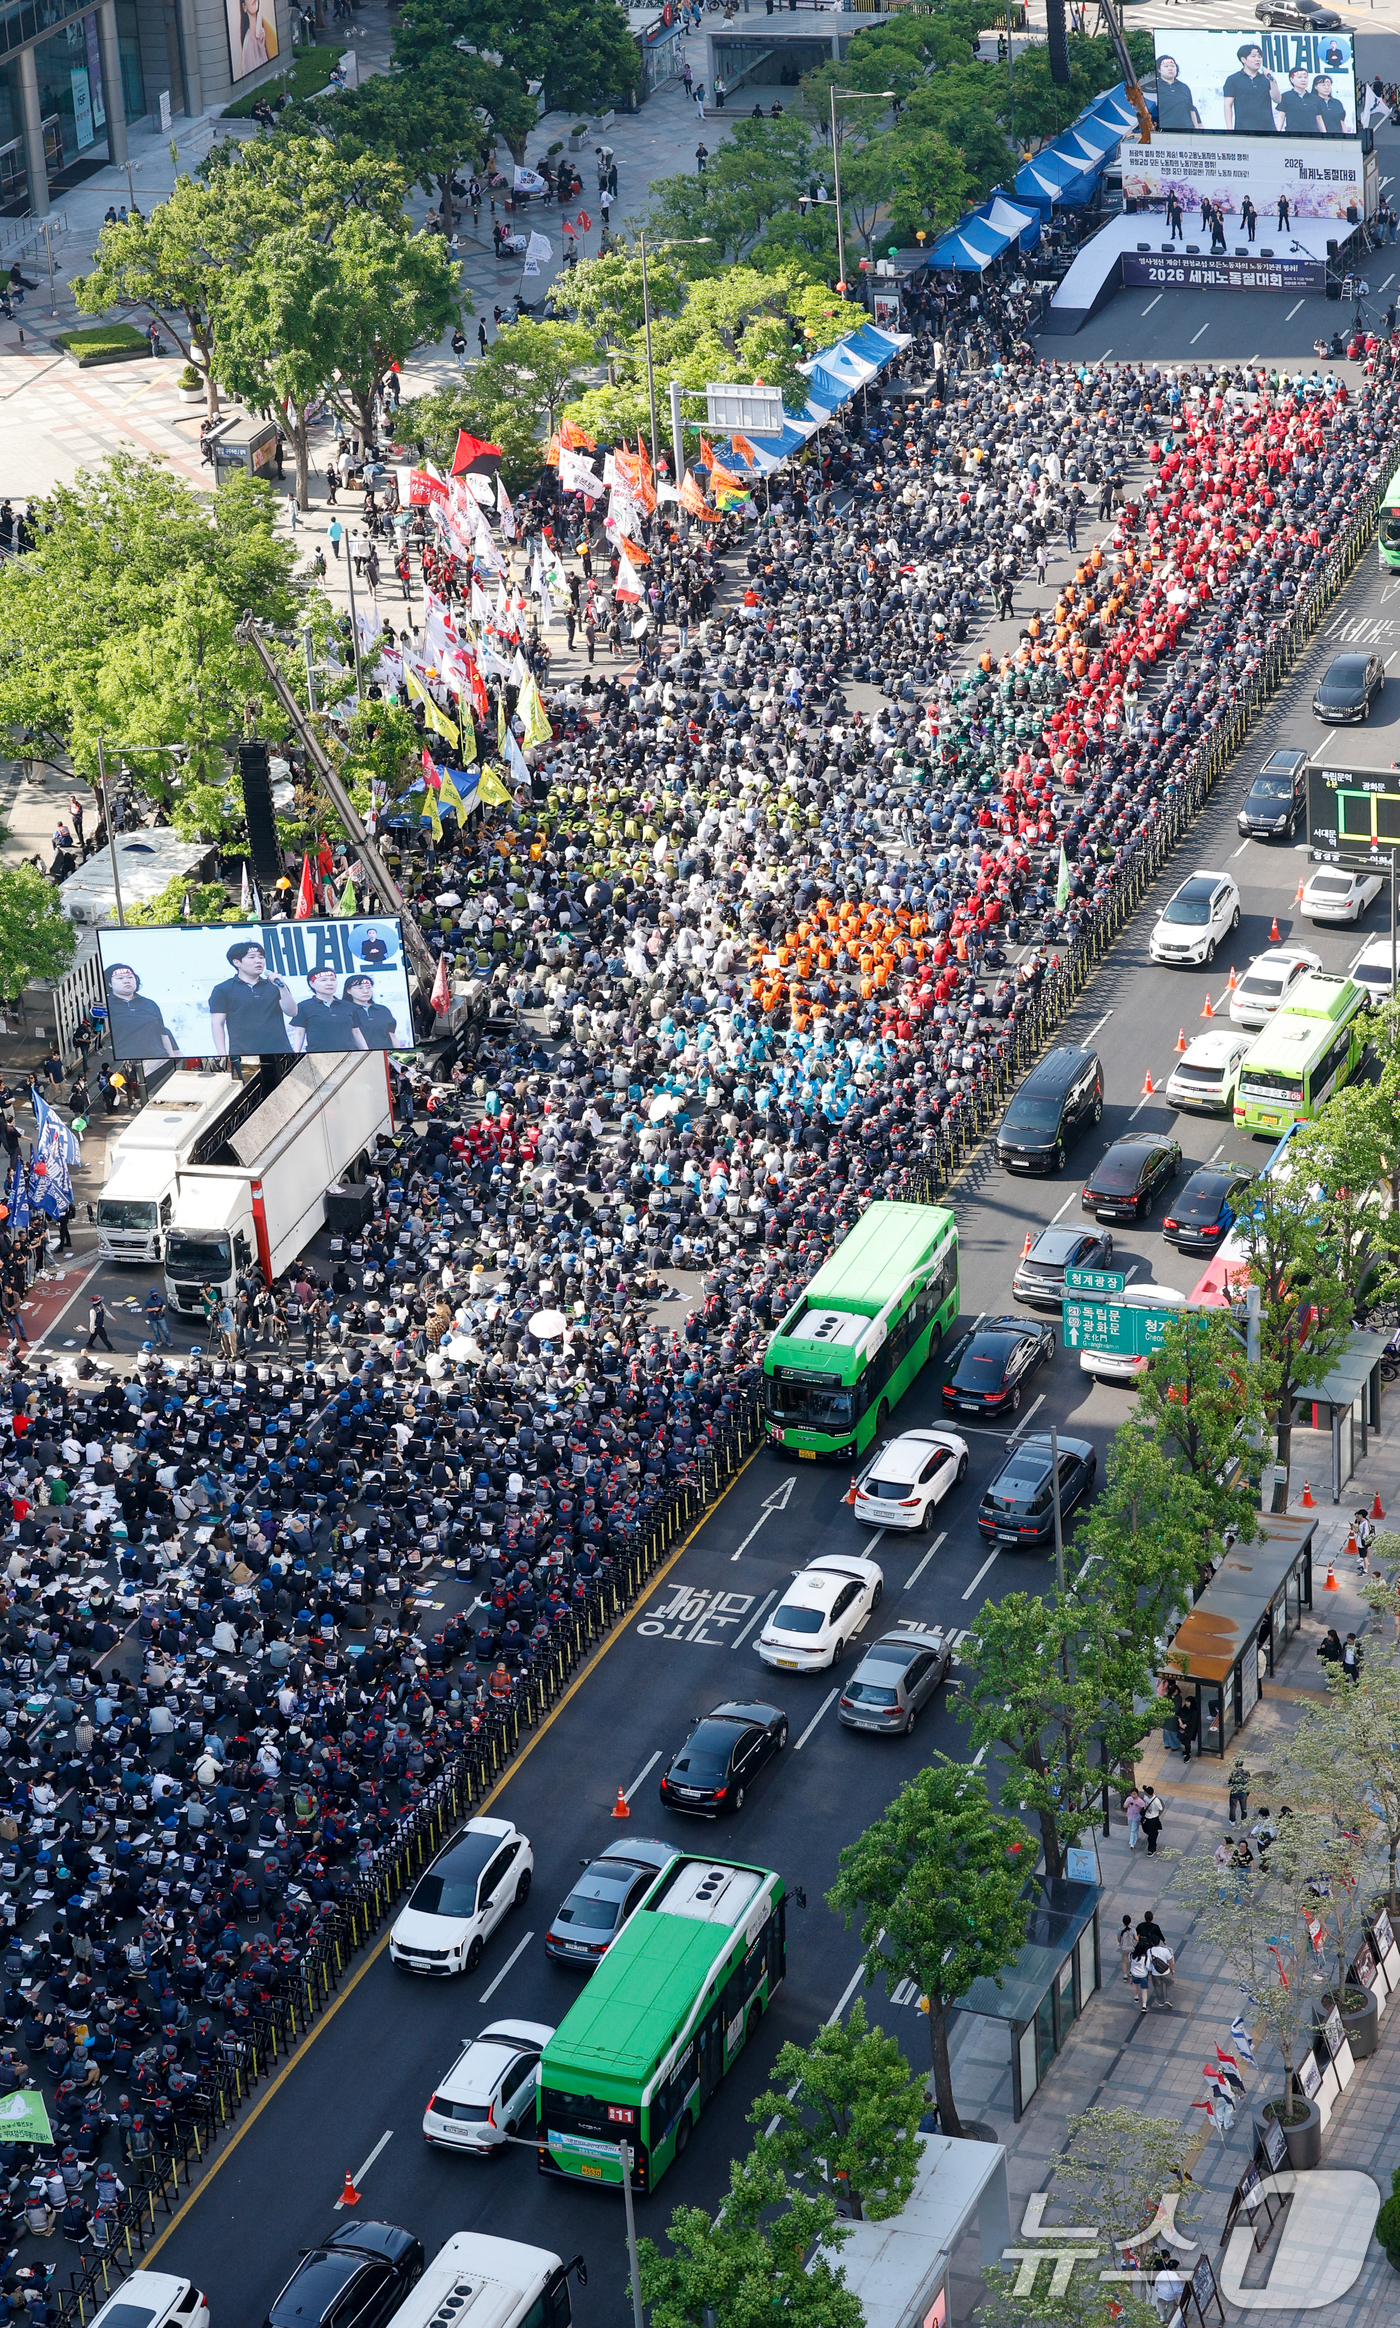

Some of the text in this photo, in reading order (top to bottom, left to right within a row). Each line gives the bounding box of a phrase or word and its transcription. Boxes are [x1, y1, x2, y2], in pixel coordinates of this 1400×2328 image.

[1284, 159, 1304, 168] 2026
[1299, 168, 1356, 181] 세계노동절대회
[1149, 268, 1282, 287] 2026 세계노동절대회
[1321, 771, 1352, 782] 독립문역
[1326, 780, 1338, 789] 6분
[1362, 781, 1386, 792] 광화문
[1313, 828, 1337, 839] 서대문
[1328, 838, 1337, 848] 역
[1291, 1093, 1301, 1101] 09
[1071, 1273, 1118, 1289] 청계광장
[1068, 1307, 1079, 1315] 21
[1082, 1306, 1121, 1322] 독립문
[1068, 1318, 1080, 1326] 50
[1082, 1319, 1121, 1336] 광화문
[1083, 1333, 1108, 1343] 光化門
[636, 1583, 756, 1646] 광화문
[616, 2110, 632, 2122] 11
